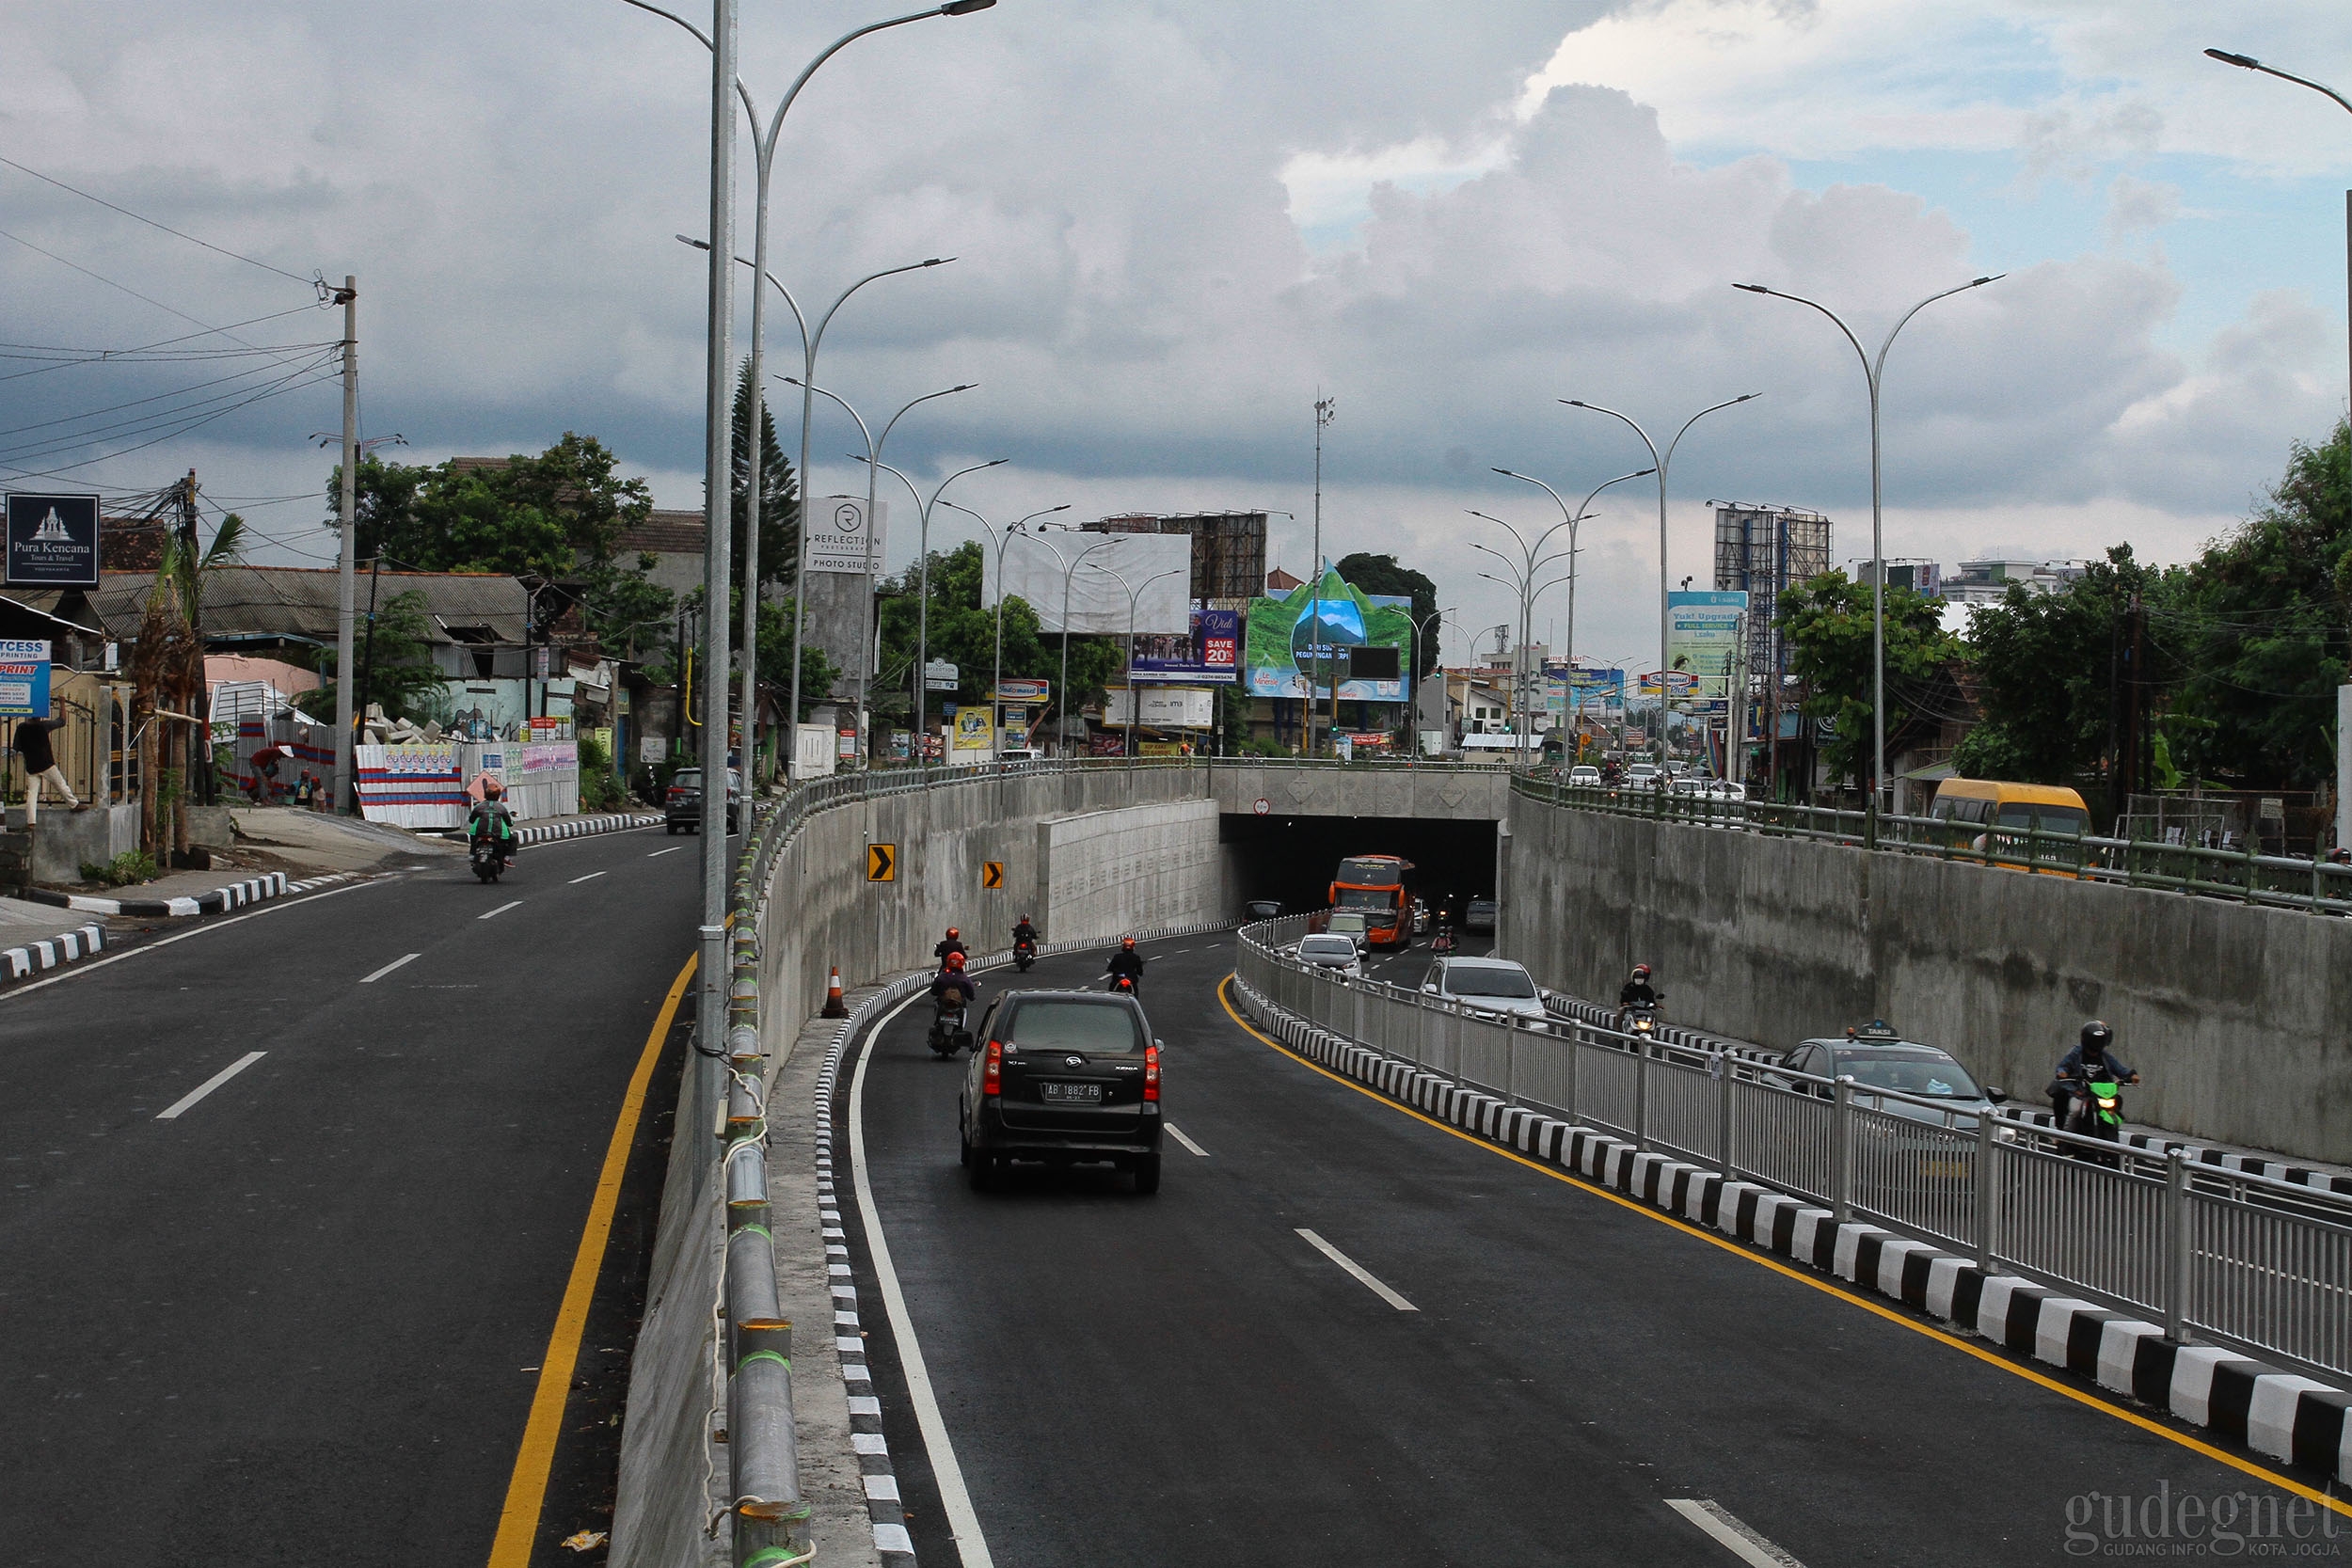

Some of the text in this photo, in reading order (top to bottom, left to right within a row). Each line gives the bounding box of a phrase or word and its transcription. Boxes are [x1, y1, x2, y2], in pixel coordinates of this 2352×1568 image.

[814, 534, 881, 546] REFLECTIN
[14, 542, 90, 554] Pura Kencana
[813, 559, 880, 570] PHOTO STUDO
[1204, 613, 1233, 630] Vidi
[1207, 640, 1232, 648] SAVE
[1670, 686, 1690, 694] Plus
[1047, 1085, 1100, 1096] AB 1882 FB
